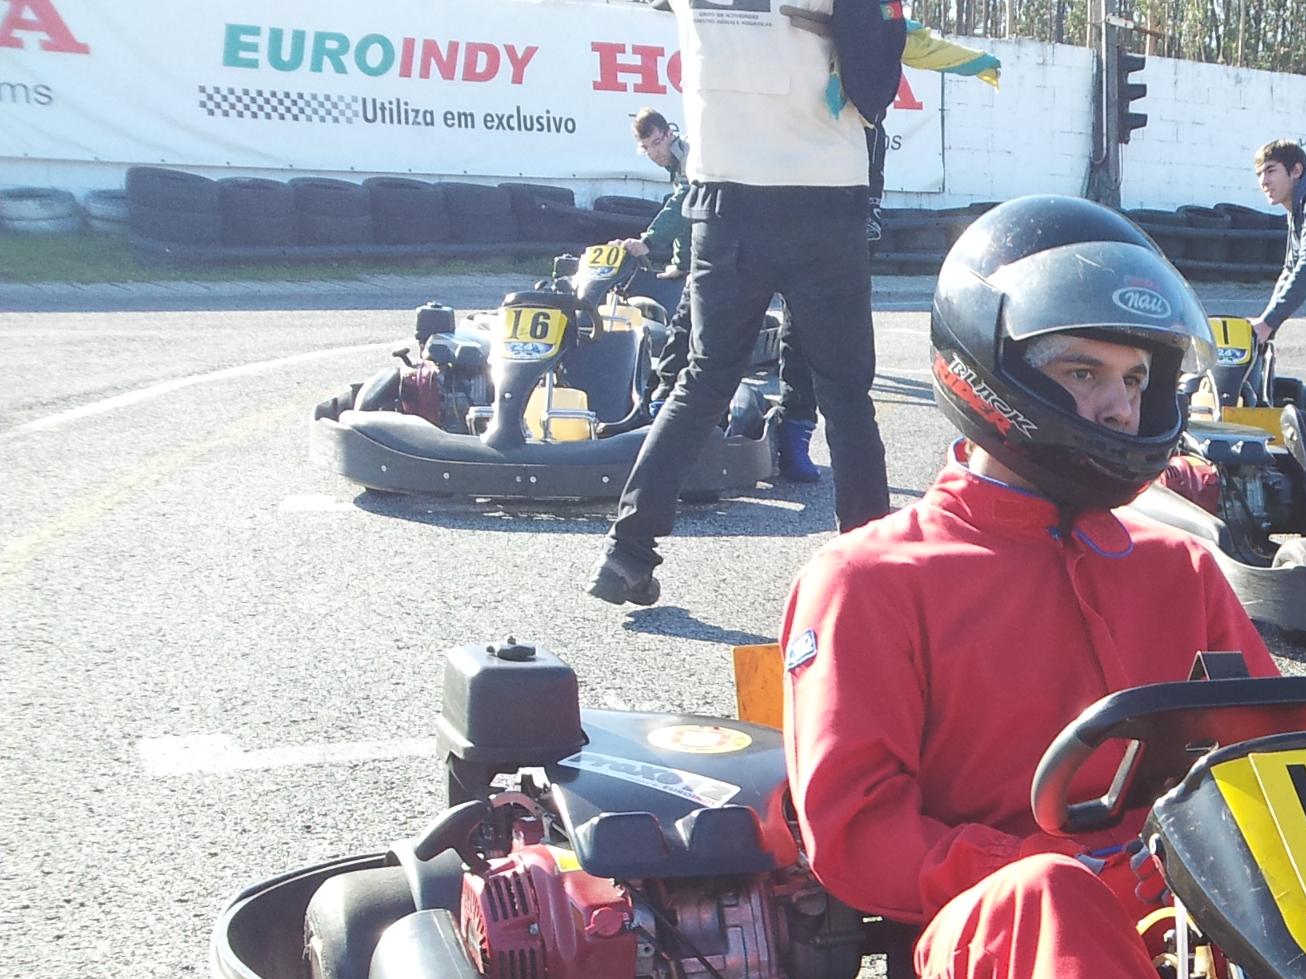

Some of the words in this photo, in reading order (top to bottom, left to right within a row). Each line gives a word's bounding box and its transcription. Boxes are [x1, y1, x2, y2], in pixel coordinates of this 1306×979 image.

[222, 23, 539, 85] EUROINDY
[361, 97, 435, 126] Utiliza
[443, 109, 475, 129] em
[483, 105, 577, 134] exclusivo
[590, 246, 620, 266] 20
[508, 309, 551, 340] 16
[947, 352, 1038, 439] BLACK
